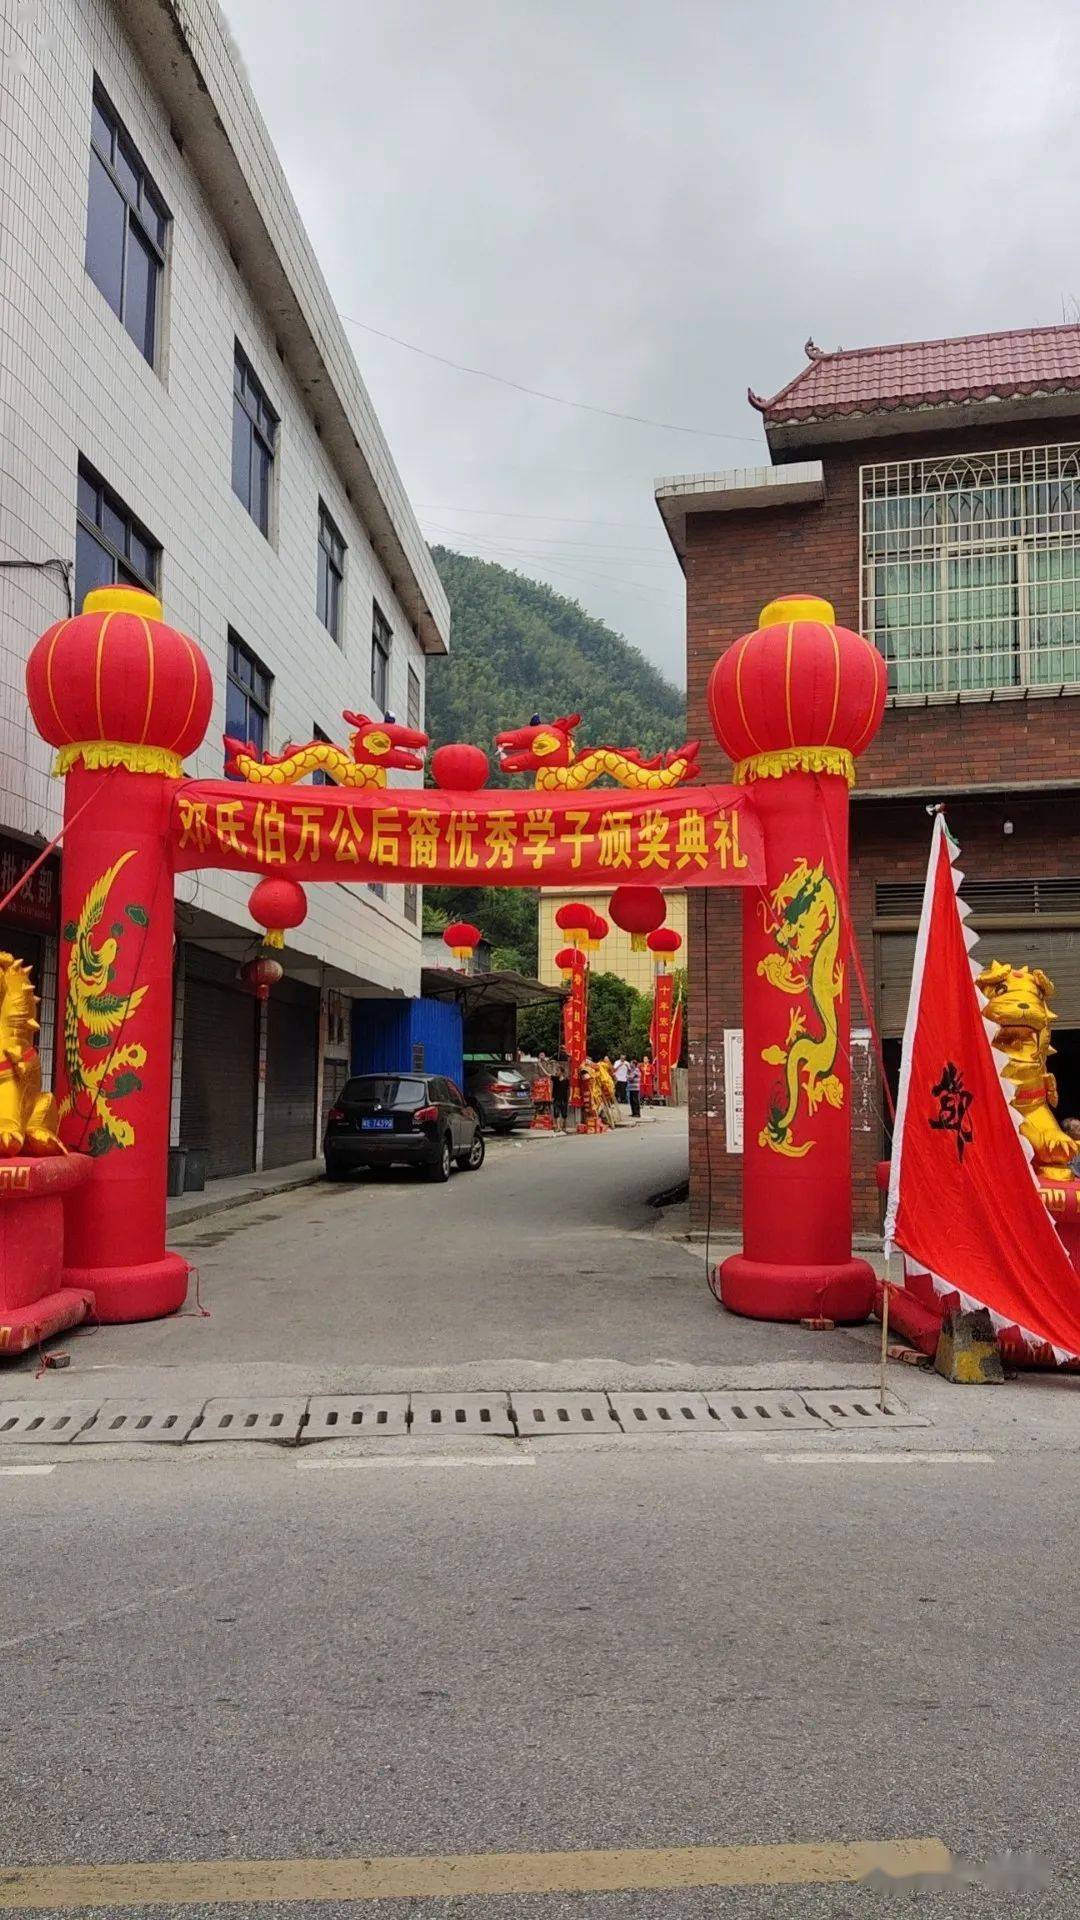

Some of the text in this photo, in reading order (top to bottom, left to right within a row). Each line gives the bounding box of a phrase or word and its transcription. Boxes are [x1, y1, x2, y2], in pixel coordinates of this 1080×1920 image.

[178, 798, 748, 869] 邓氏伯万公后裔优秀学子颁奖典礼
